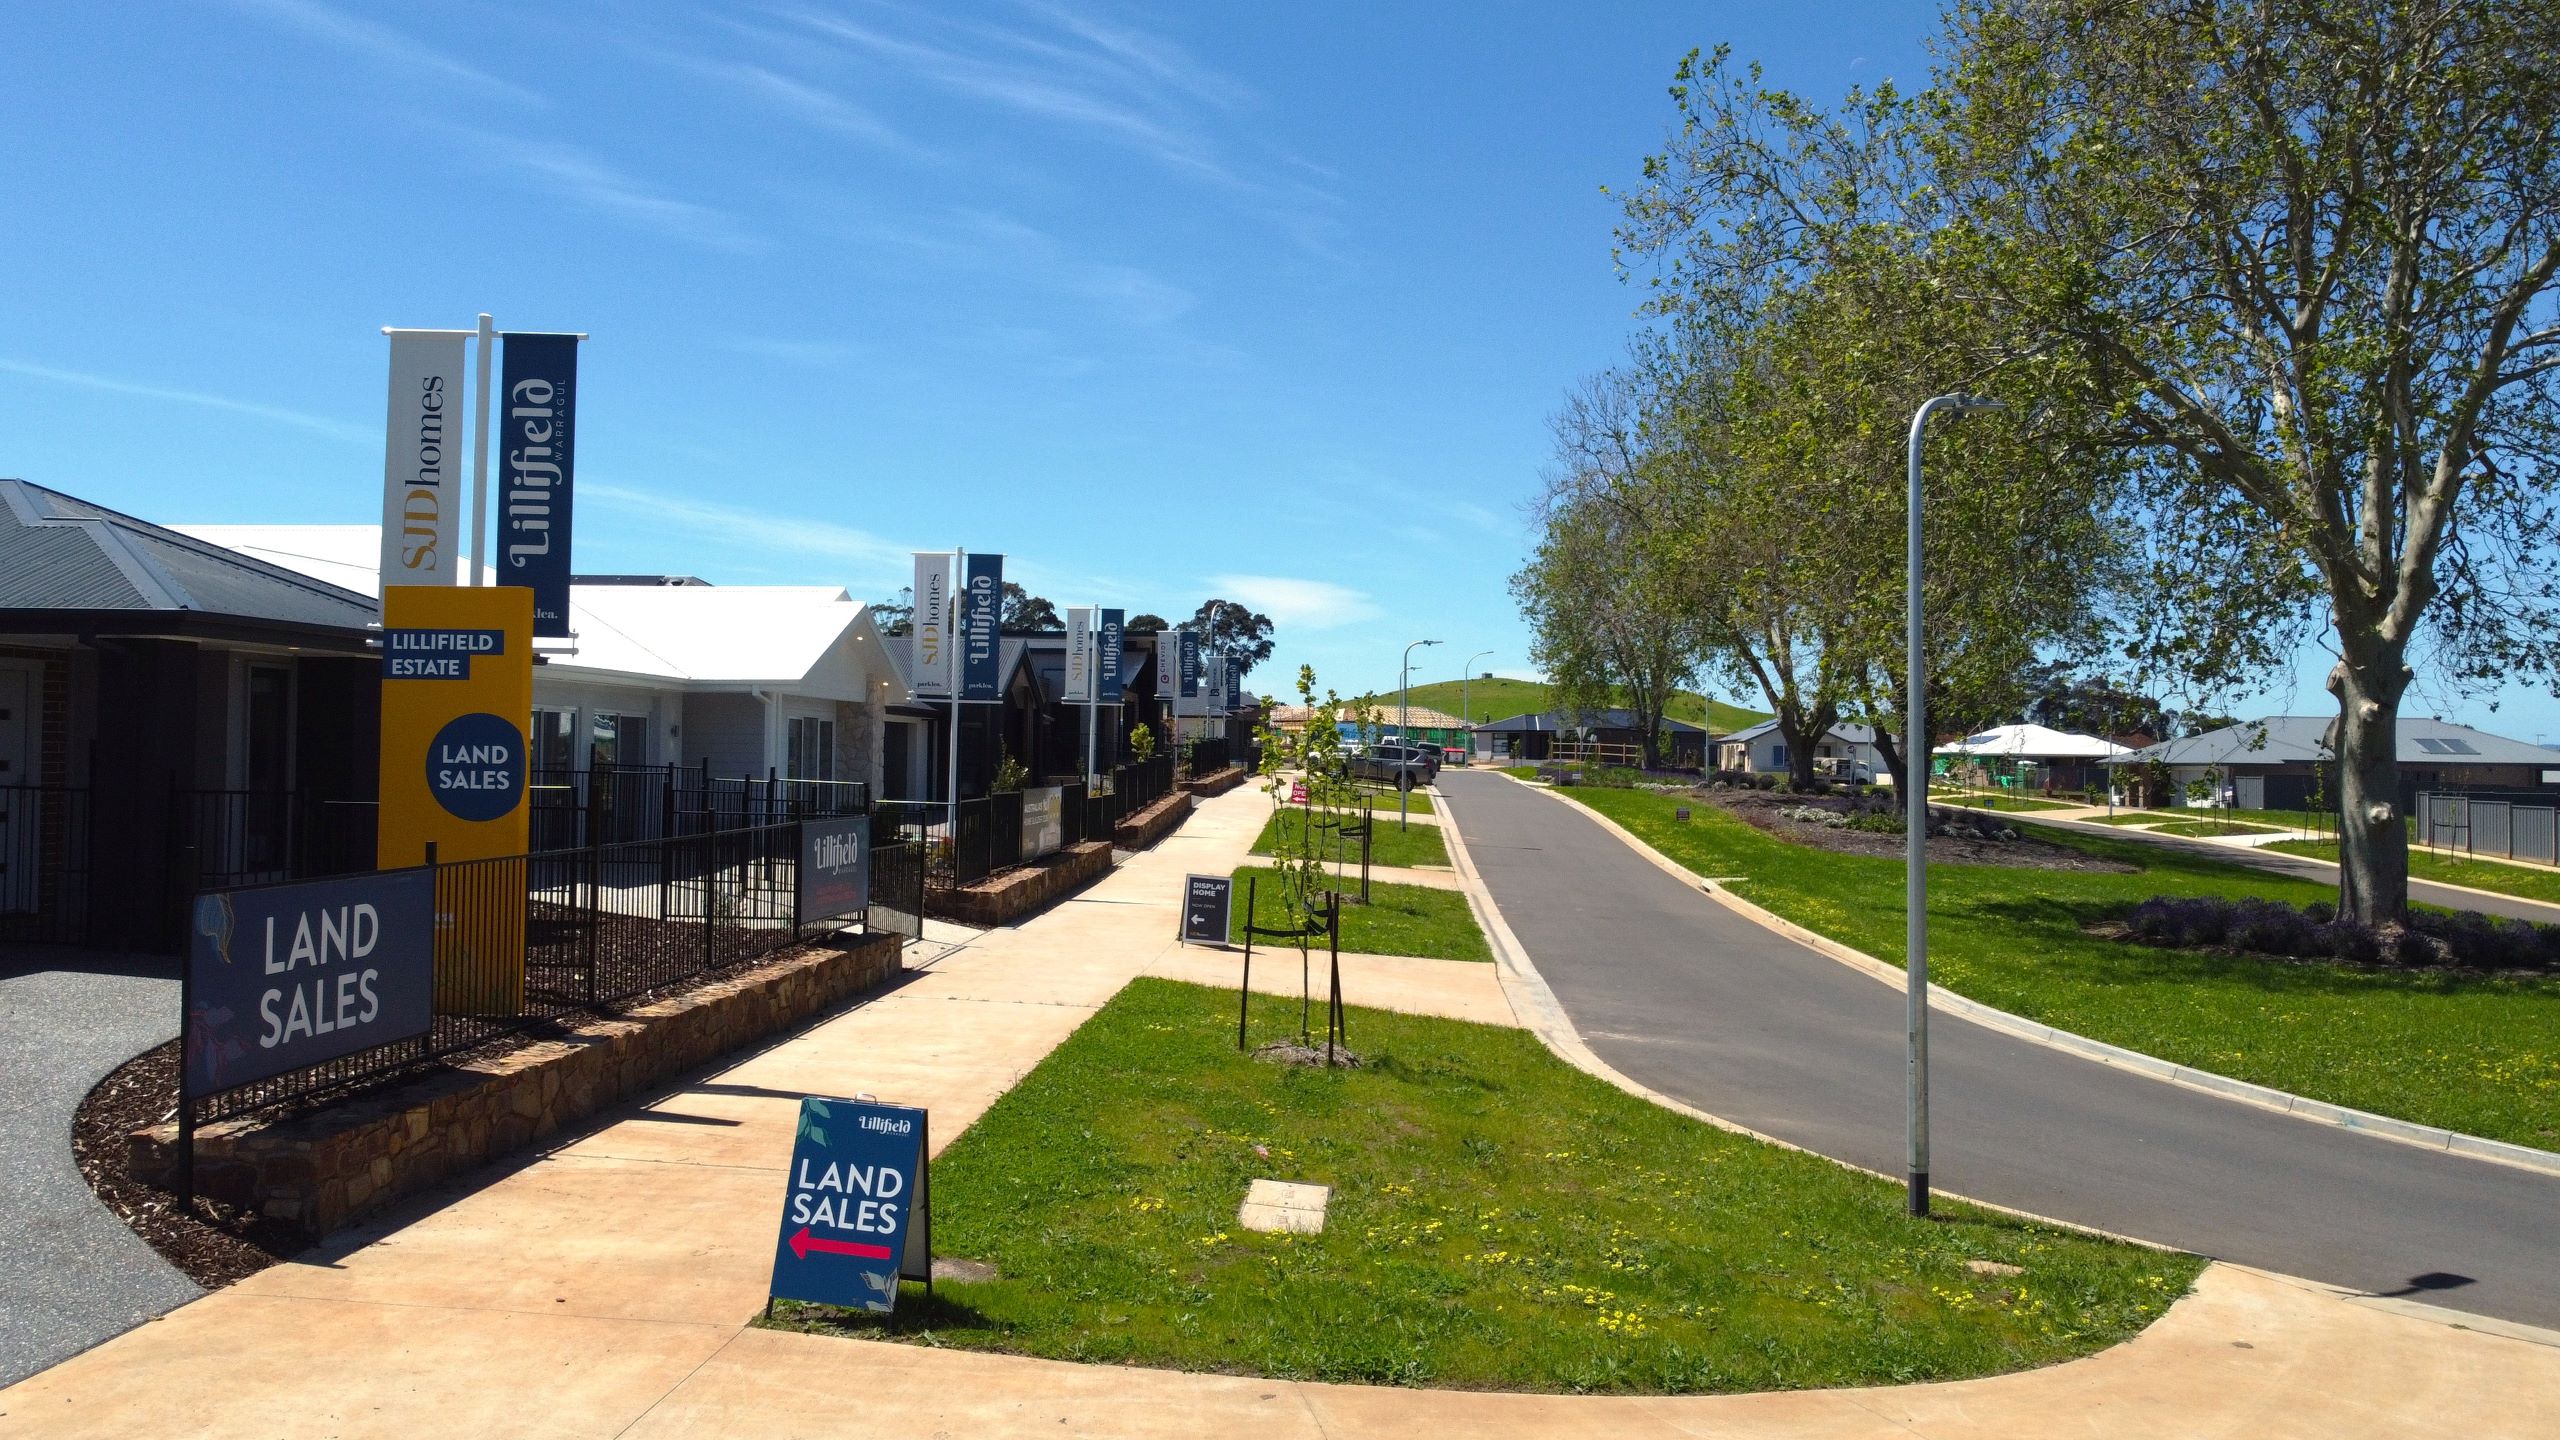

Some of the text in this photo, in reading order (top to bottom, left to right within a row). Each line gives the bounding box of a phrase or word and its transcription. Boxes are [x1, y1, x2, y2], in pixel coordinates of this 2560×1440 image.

[554, 379, 566, 461] WARRAGUL
[509, 378, 562, 567] Lillifield
[970, 575, 996, 665] Lillifield
[392, 633, 493, 651] LILLIFIELD
[1103, 622, 1120, 681] Lillifield
[391, 658, 460, 676] ESTATE
[442, 744, 509, 765] LAND
[439, 770, 510, 790] SALES
[814, 832, 858, 875] Lillifield
[1193, 882, 1226, 891] DISPLAY
[1193, 889, 1216, 897] HOME
[265, 903, 379, 976] LAND
[259, 968, 379, 1049] SALES
[858, 1115, 911, 1135] Lillifield
[799, 1158, 903, 1198] LAND
[791, 1193, 899, 1235] SALES
